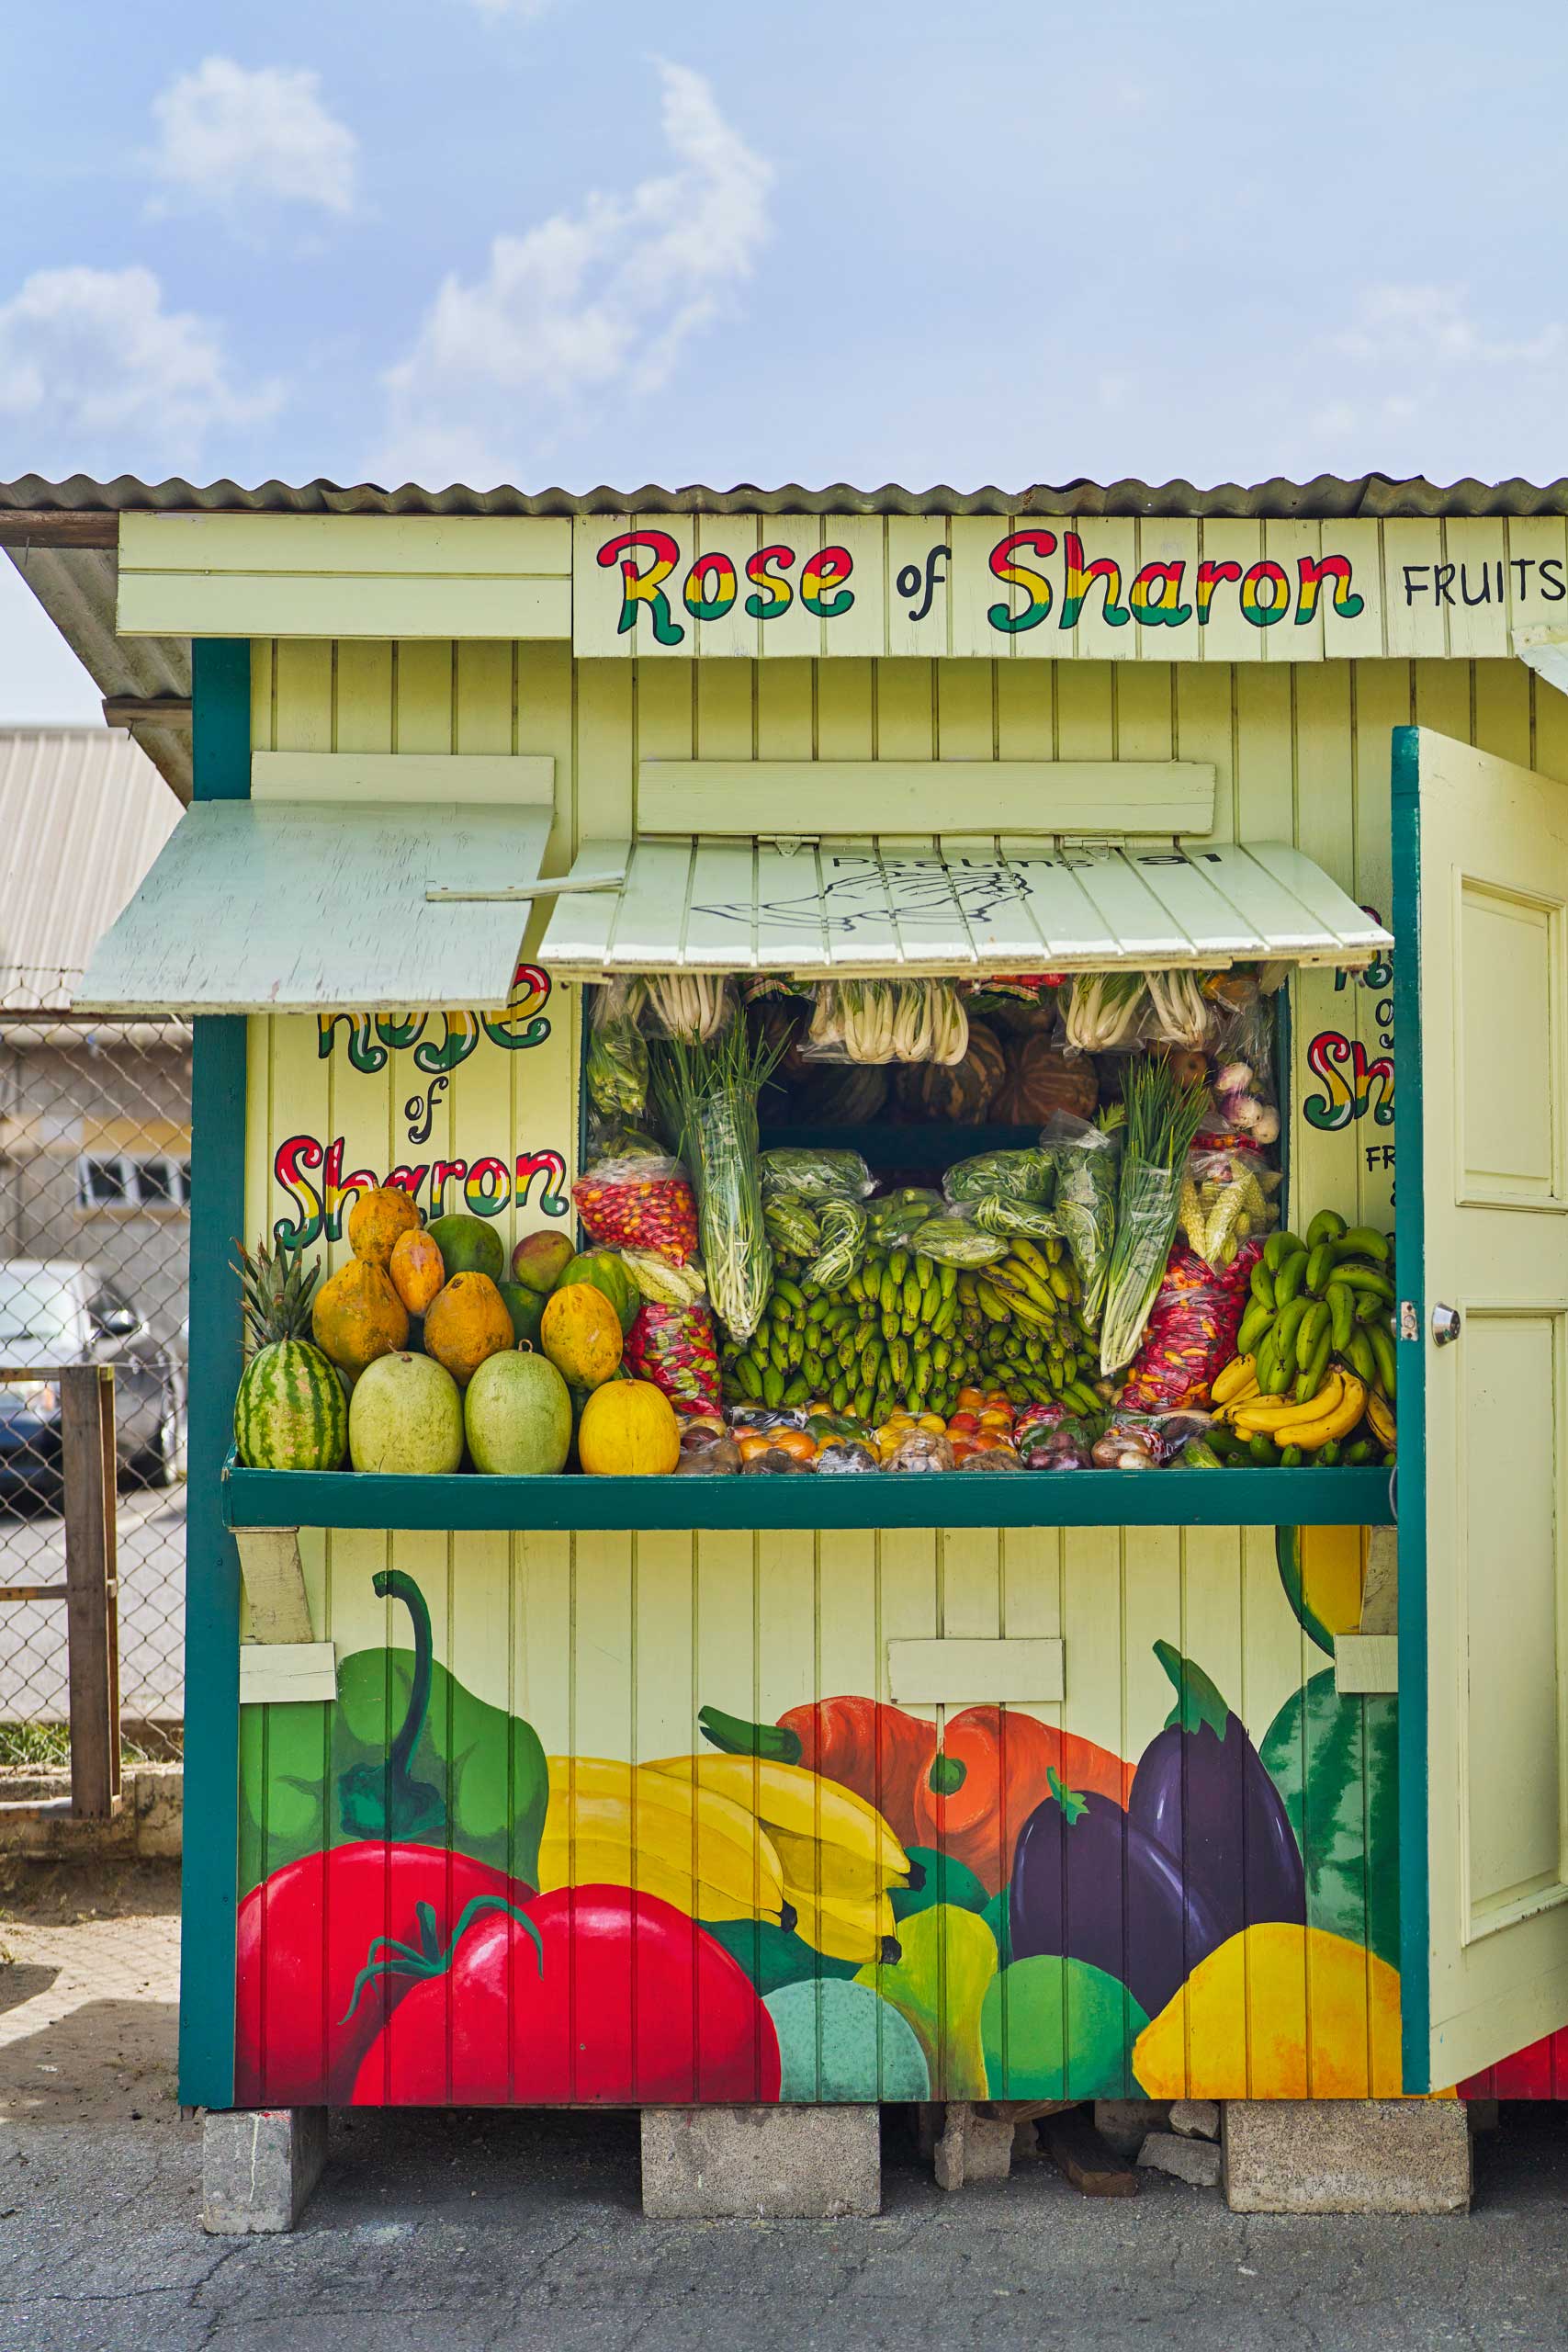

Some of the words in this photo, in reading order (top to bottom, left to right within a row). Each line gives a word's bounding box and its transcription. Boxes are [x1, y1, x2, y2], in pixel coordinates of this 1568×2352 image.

[597, 529, 855, 646] Rose
[897, 545, 952, 621] of
[987, 529, 1364, 633] Sharon
[1403, 559, 1566, 606] FRUITS
[832, 857, 1094, 869] Psalms
[1136, 853, 1222, 865] 91
[404, 1076, 449, 1144] of
